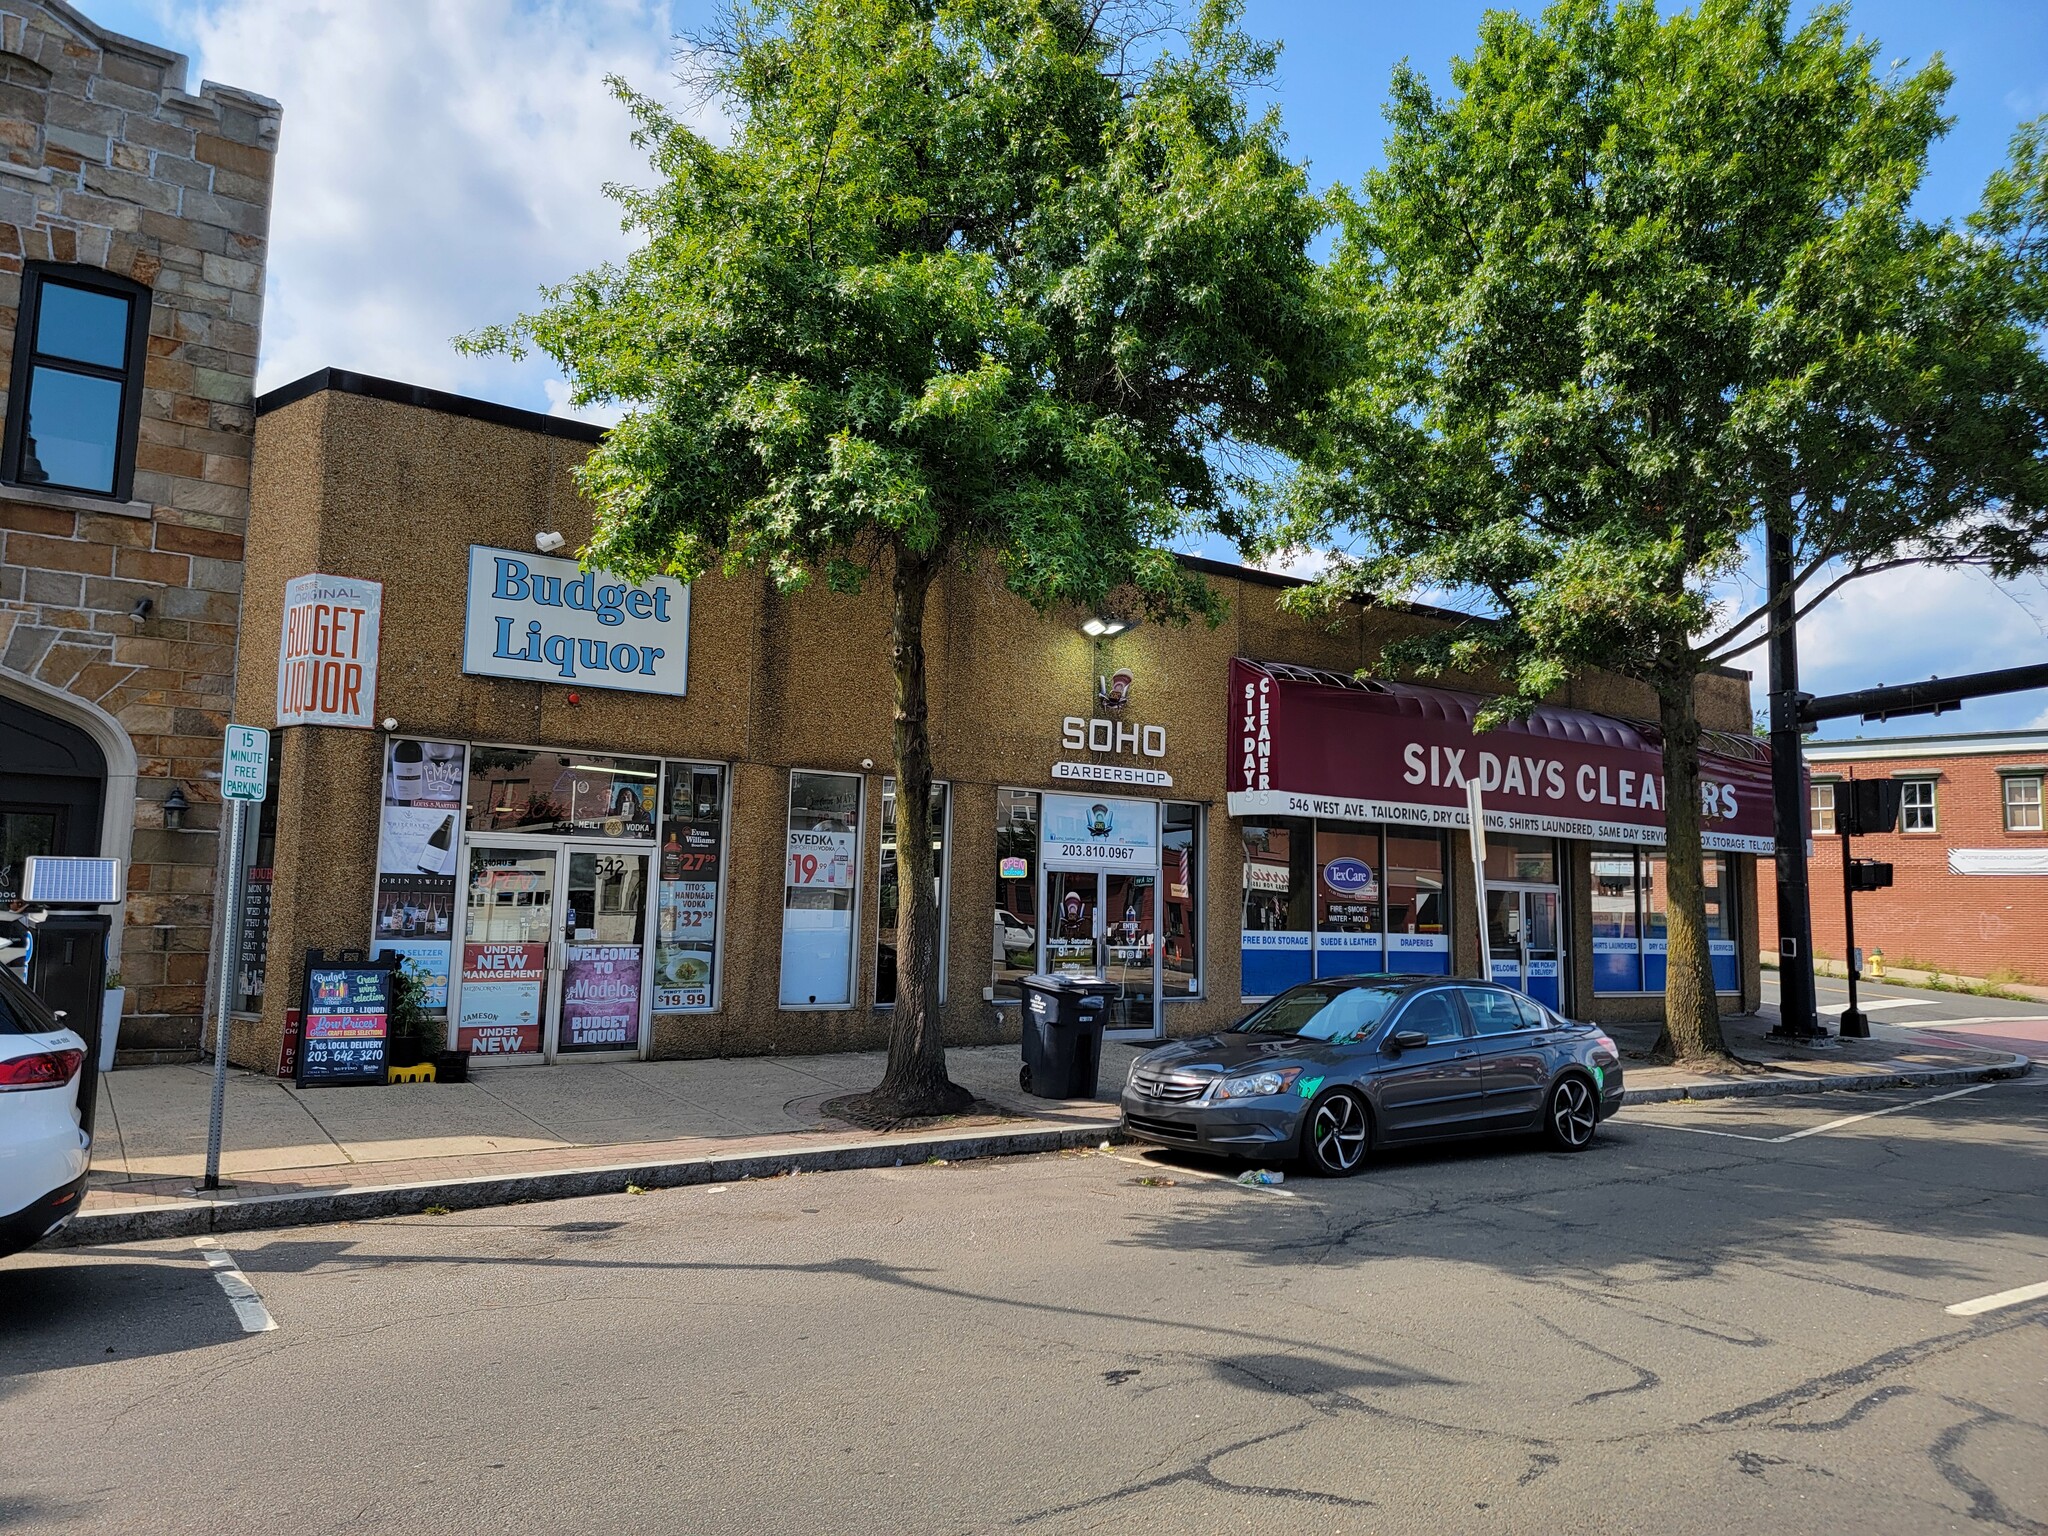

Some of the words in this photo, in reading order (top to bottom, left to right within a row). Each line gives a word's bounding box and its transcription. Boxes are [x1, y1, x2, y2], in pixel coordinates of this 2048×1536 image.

[295, 588, 360, 604] ORIGINAL
[492, 557, 672, 626] Budget
[287, 604, 366, 660] BUDGET
[493, 616, 666, 678] Liquor
[283, 660, 363, 717] LIQUOR
[1244, 683, 1256, 732] SIX
[242, 732, 254, 748] 15
[1062, 716, 1166, 758] SOHO
[1258, 677, 1270, 806] CLEANERS
[231, 749, 263, 764] MINUTE
[234, 765, 257, 778] FREE
[1060, 764, 1166, 784] BARBERSHOP
[1243, 737, 1256, 802] DAYS
[1403, 742, 1467, 790] SIX
[1479, 751, 1566, 800] DAYS
[1576, 764, 1739, 819] CLEARS
[227, 780, 263, 794] PARKING
[578, 821, 601, 829] MEILI
[626, 823, 650, 831] VODKA
[1289, 798, 1310, 812] 546
[1313, 800, 1340, 816] WEST
[1344, 804, 1368, 818] AVE.
[1371, 806, 1432, 825] TAILORING,
[1433, 811, 1453, 825] DRY
[1454, 812, 1507, 830] CLEING,
[1509, 817, 1540, 831] SHIRTS
[1541, 820, 1596, 837] LAUNDERED,
[1598, 827, 1621, 839] SAME
[1623, 828, 1639, 840] DAY
[1641, 829, 1668, 843] SERVIC
[1700, 834, 1711, 847] OX
[1713, 836, 1745, 849] STORAGE
[686, 836, 716, 844] Williams
[790, 834, 834, 846] SVEDKA
[1062, 844, 1135, 860] 203.810.0967
[594, 859, 625, 877] 542
[1003, 859, 1025, 870] OPEN
[249, 868, 273, 880] HOUR
[1330, 866, 1367, 882] TexCare
[477, 870, 534, 891] OPEN
[248, 885, 262, 893] MON
[684, 883, 706, 891] TITO'S
[247, 896, 262, 904] TUE
[675, 891, 714, 900] HANDMADE
[683, 900, 706, 908] VODKA
[1330, 905, 1343, 913] FIRE
[246, 907, 261, 916] WED
[245, 919, 260, 927] THU
[1352, 915, 1369, 923] MOLD
[244, 930, 255, 939] FRI
[1243, 936, 1261, 945] FREE
[1262, 936, 1277, 945] BOX
[1278, 936, 1309, 945] STORAGE
[242, 942, 258, 950] SAT
[1049, 937, 1068, 946] Monday
[1071, 937, 1094, 946] Saturday
[1320, 937, 1343, 946] SUEDE
[1344, 938, 1348, 946] &
[1349, 937, 1377, 946] LEATHER
[1400, 938, 1434, 948] DRAPERIES
[1609, 942, 1638, 950] LAUNDERED
[407, 949, 443, 957] SELTZER
[484, 945, 523, 954] UNDER
[568, 947, 640, 961] WELCOME
[242, 953, 256, 962] SUN
[477, 954, 528, 970] NEW
[593, 961, 614, 975] TO
[1062, 962, 1081, 970] Sunday
[1491, 964, 1518, 973] WELCOME
[314, 971, 348, 983] Budget
[356, 974, 379, 984] Great
[463, 970, 543, 979] MANAGEMENT
[359, 984, 378, 993] wine
[574, 979, 629, 998] Modelo
[353, 993, 386, 1003] selection
[658, 993, 706, 1006] $19.99
[312, 1006, 332, 1014] WINE
[337, 1006, 354, 1014] BEER
[360, 1006, 385, 1014] LIQUOR
[316, 1016, 341, 1030] Low
[341, 1016, 378, 1029] Prices!
[462, 1012, 499, 1023] JAMESON
[571, 1015, 630, 1030] BUDGET
[478, 1027, 518, 1037] UNDER
[572, 1028, 626, 1044] LIQUOR
[308, 1040, 327, 1050] Free
[328, 1041, 349, 1049] LOCAL
[350, 1041, 383, 1049] DELIVERY
[471, 1036, 524, 1053] NEW
[307, 1049, 384, 1062] 203-642-3210
